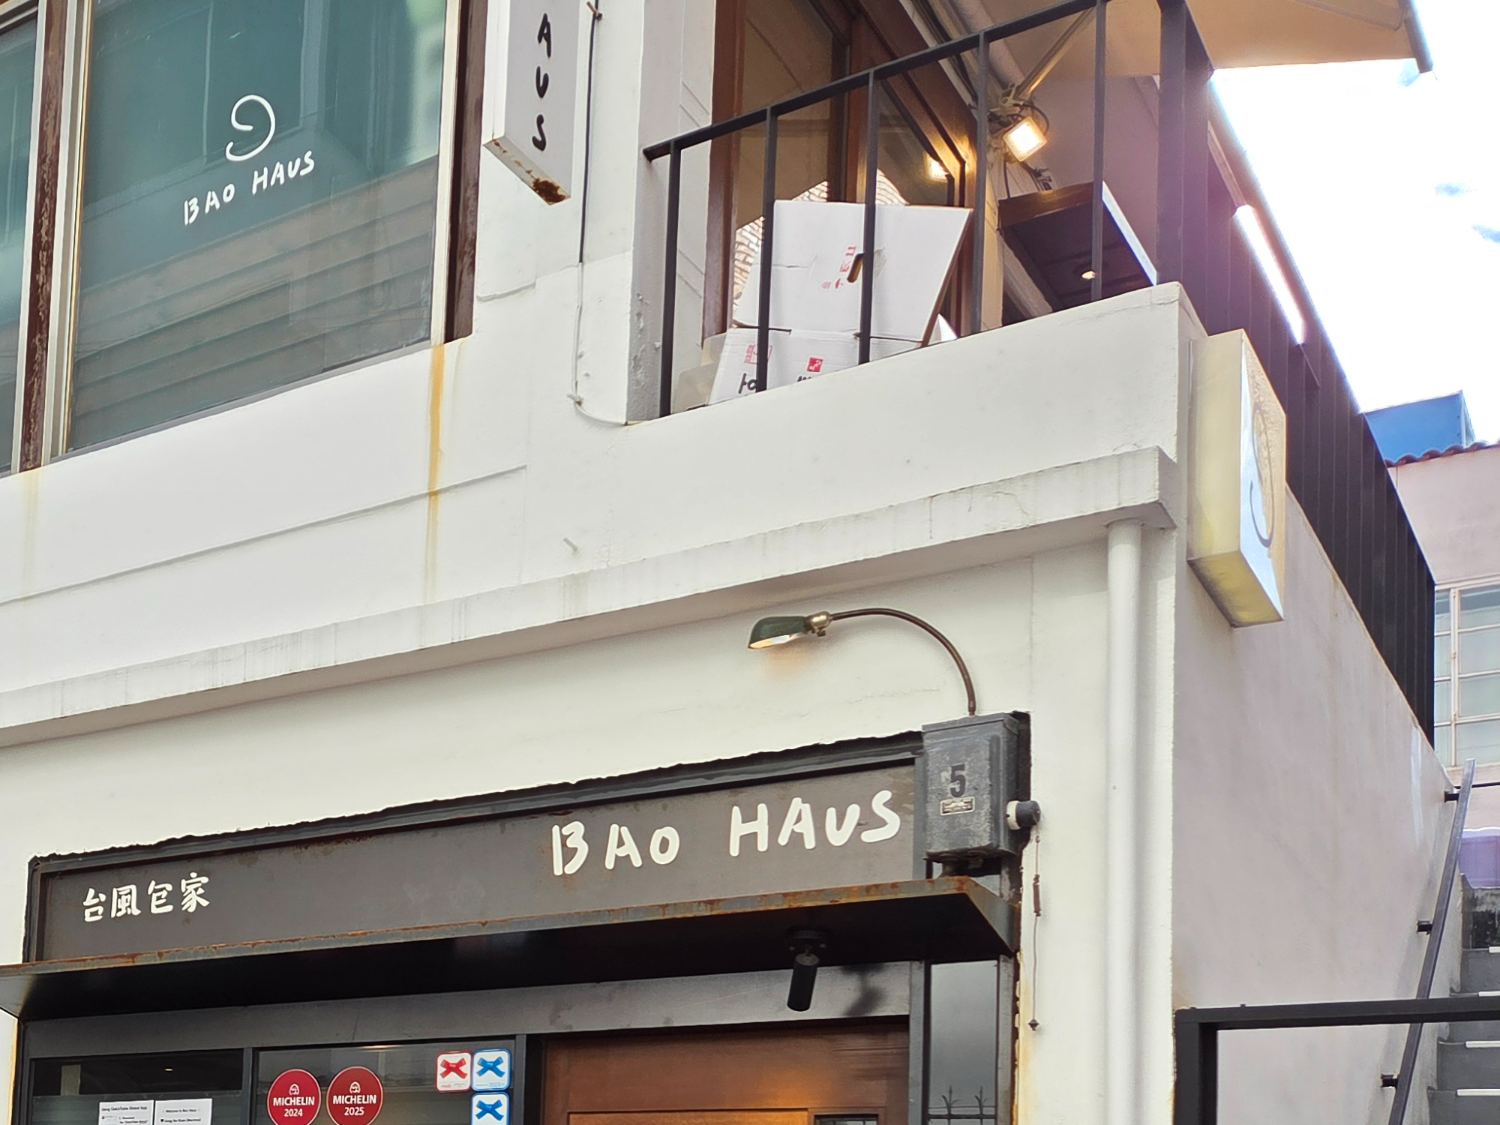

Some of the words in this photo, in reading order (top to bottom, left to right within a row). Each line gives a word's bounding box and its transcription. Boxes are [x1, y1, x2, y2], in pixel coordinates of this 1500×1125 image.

[184, 183, 236, 226] BAO
[252, 150, 315, 195] HAUS
[950, 763, 966, 798] 5
[552, 821, 680, 876] BAO
[729, 789, 901, 857] HAUS
[272, 1096, 315, 1106] MICHELIN
[332, 1094, 377, 1104] MICHELIN
[284, 1108, 303, 1117] 2024
[344, 1106, 365, 1116] 2025
